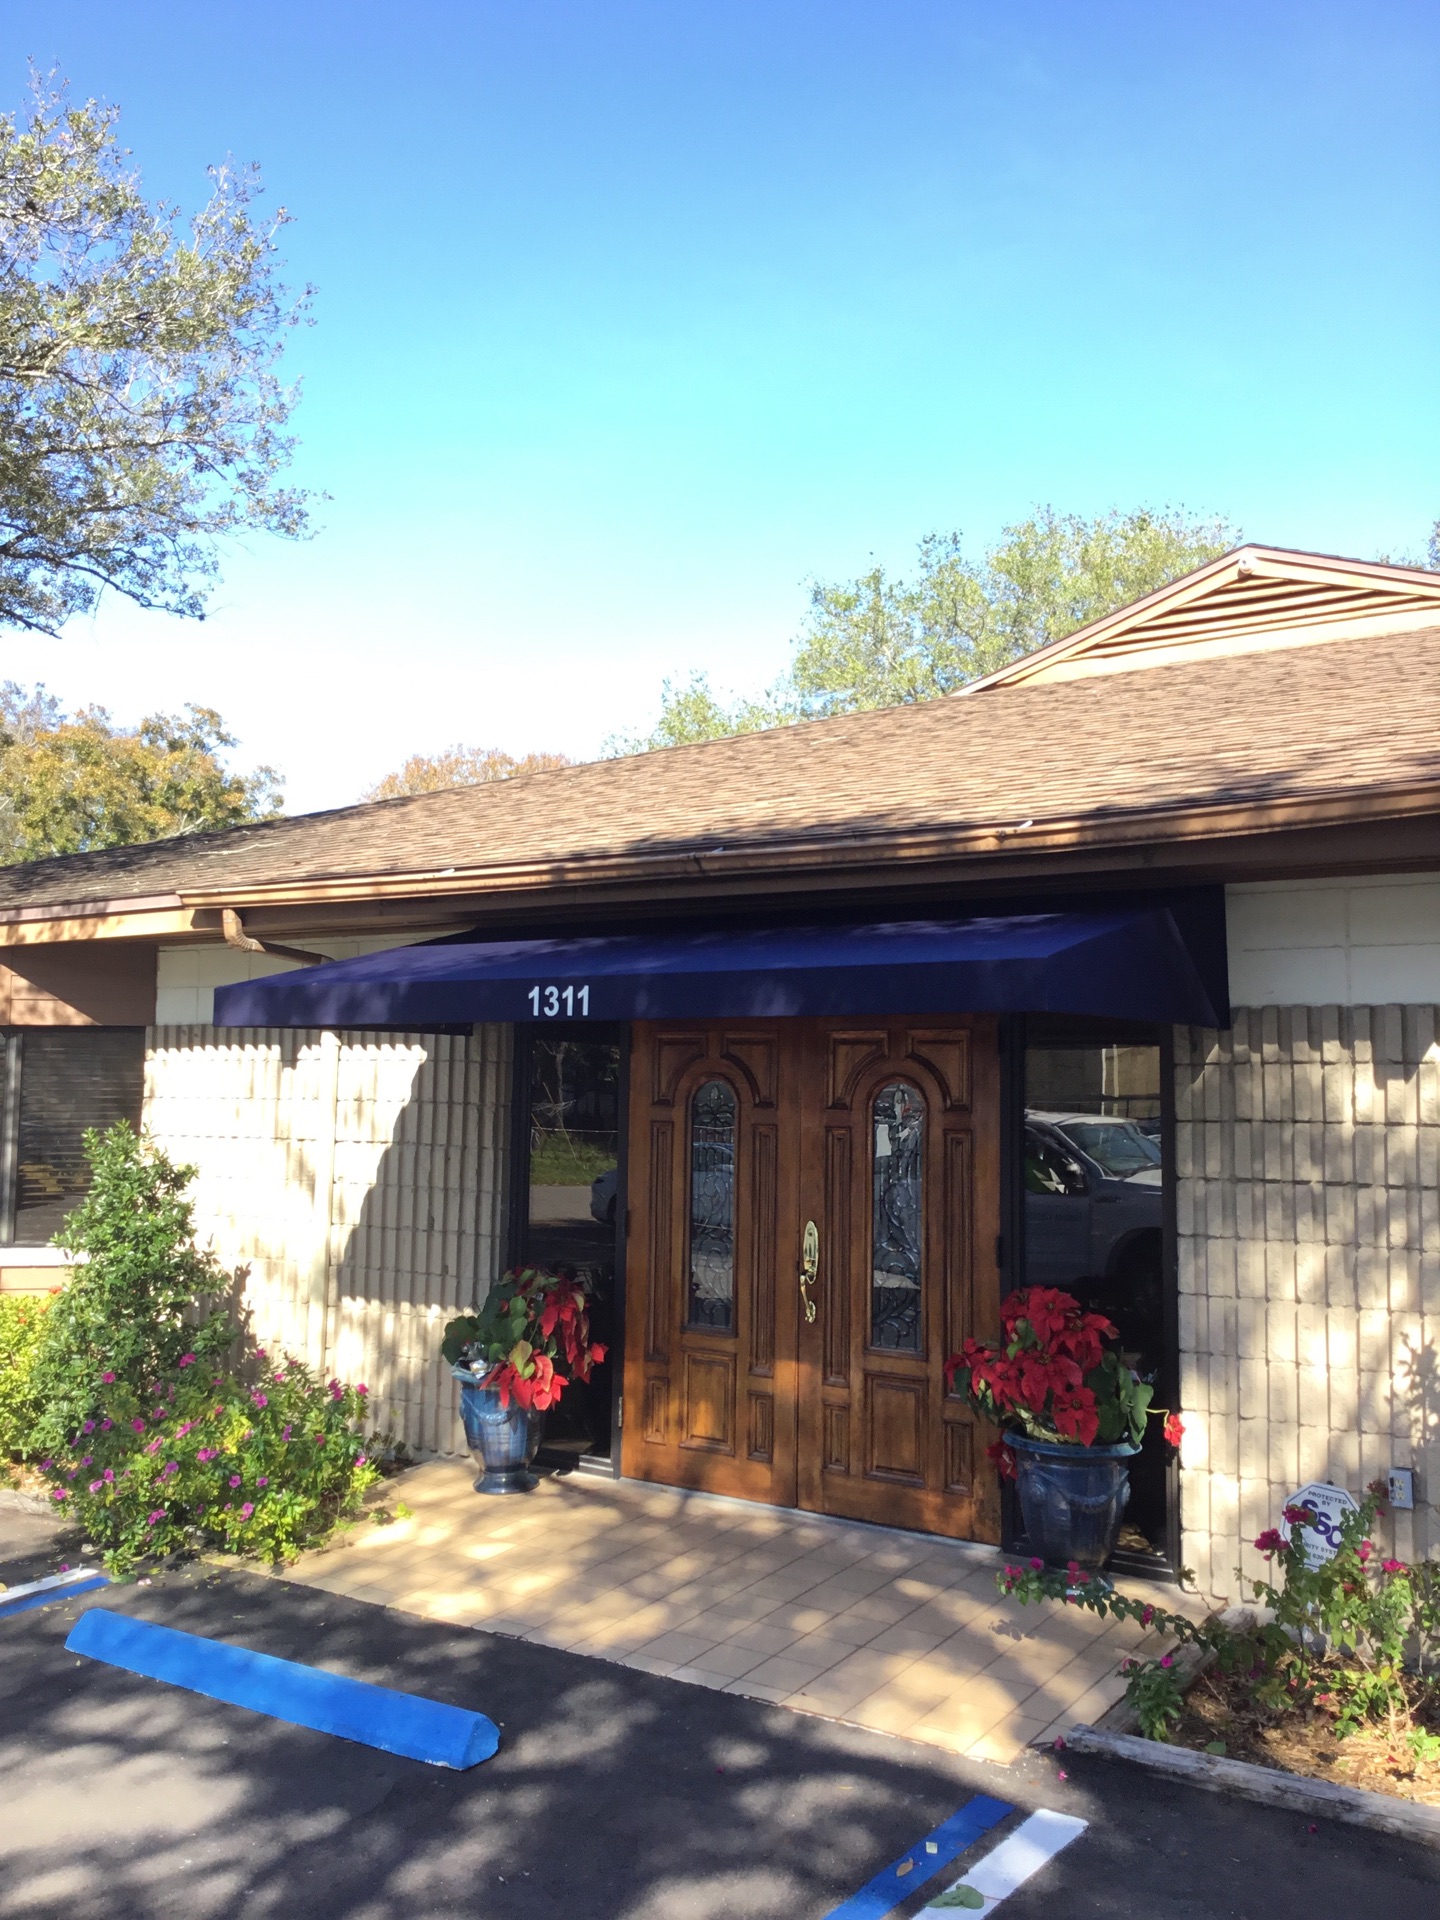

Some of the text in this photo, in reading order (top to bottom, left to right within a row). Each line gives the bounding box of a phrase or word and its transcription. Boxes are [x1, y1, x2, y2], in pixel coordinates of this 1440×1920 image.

[528, 985, 590, 1017] 1311
[1307, 1490, 1348, 1505] PROTECTED
[1320, 1546, 1338, 1556] SYST
